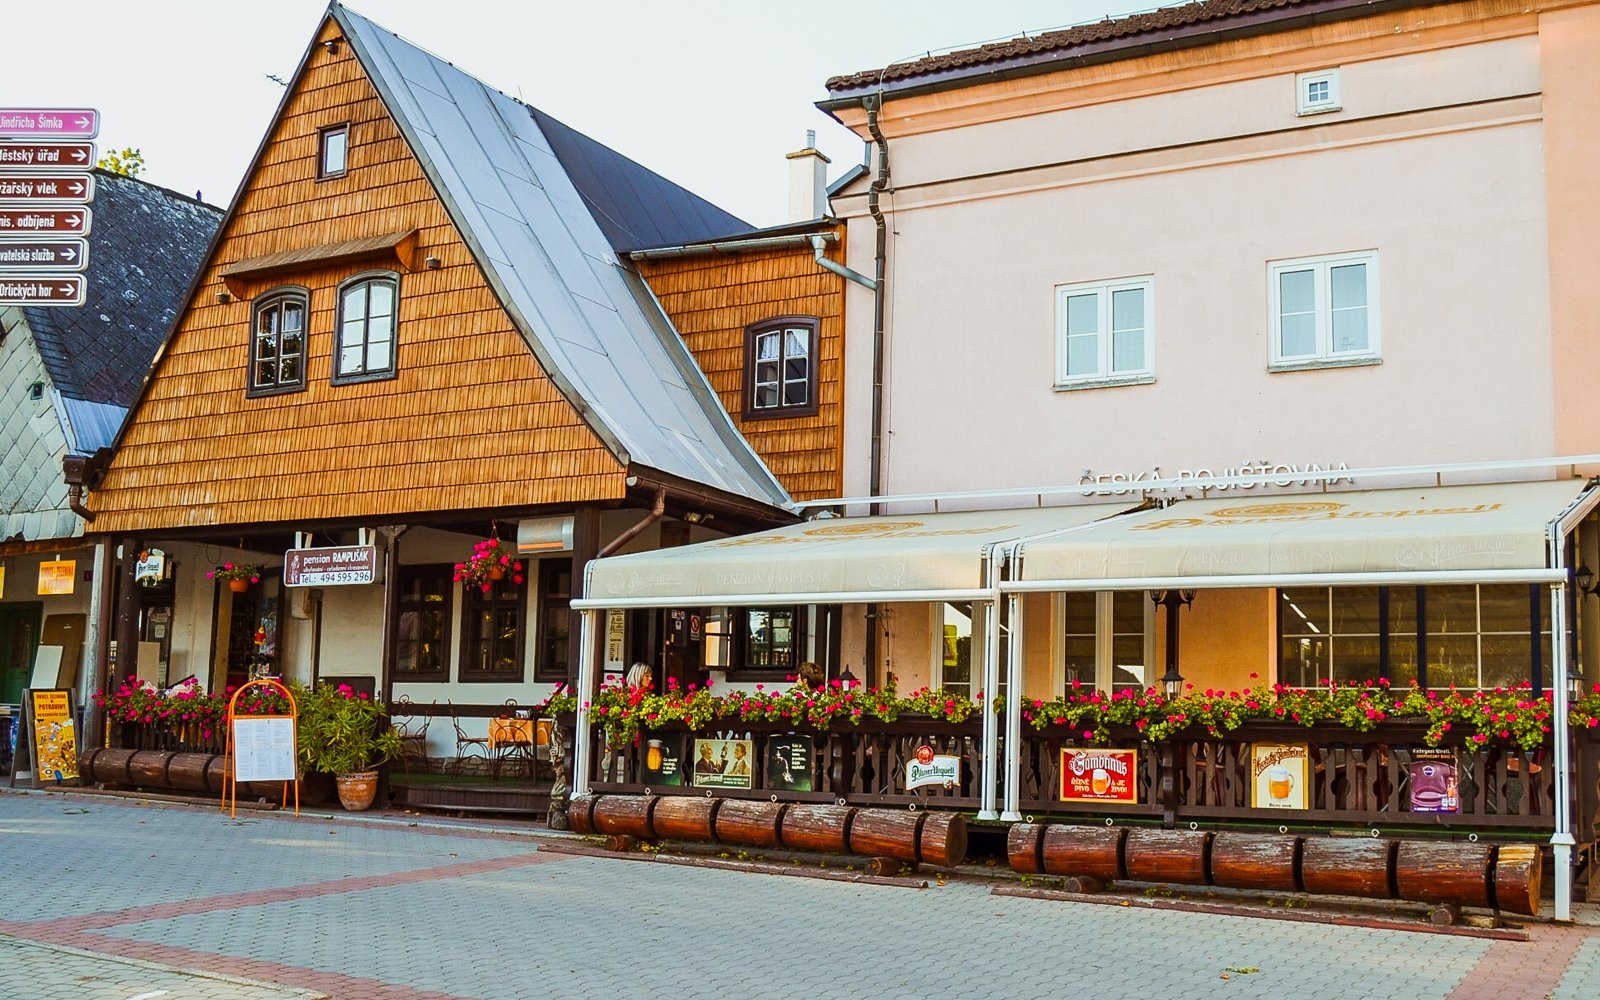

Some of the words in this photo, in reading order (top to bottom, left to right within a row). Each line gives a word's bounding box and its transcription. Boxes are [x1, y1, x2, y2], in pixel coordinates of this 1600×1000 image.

[0, 115, 35, 129] Jindřicha
[38, 113, 63, 129] Šimka
[0, 149, 34, 165] ěstský
[37, 149, 60, 162] úřad
[36, 182, 58, 195] vlek
[17, 214, 55, 230] odbíjená
[31, 248, 55, 261] služba
[0, 283, 36, 300] Orlických
[38, 283, 53, 297] hor
[1077, 467, 1166, 496] ČESKÁ
[1177, 460, 1354, 492] POJIŠŤOVNA
[303, 554, 330, 567] pension
[332, 549, 369, 562] RAMPUŠÁK
[320, 572, 336, 582] 494
[337, 571, 353, 582] 595
[354, 570, 370, 581] 296
